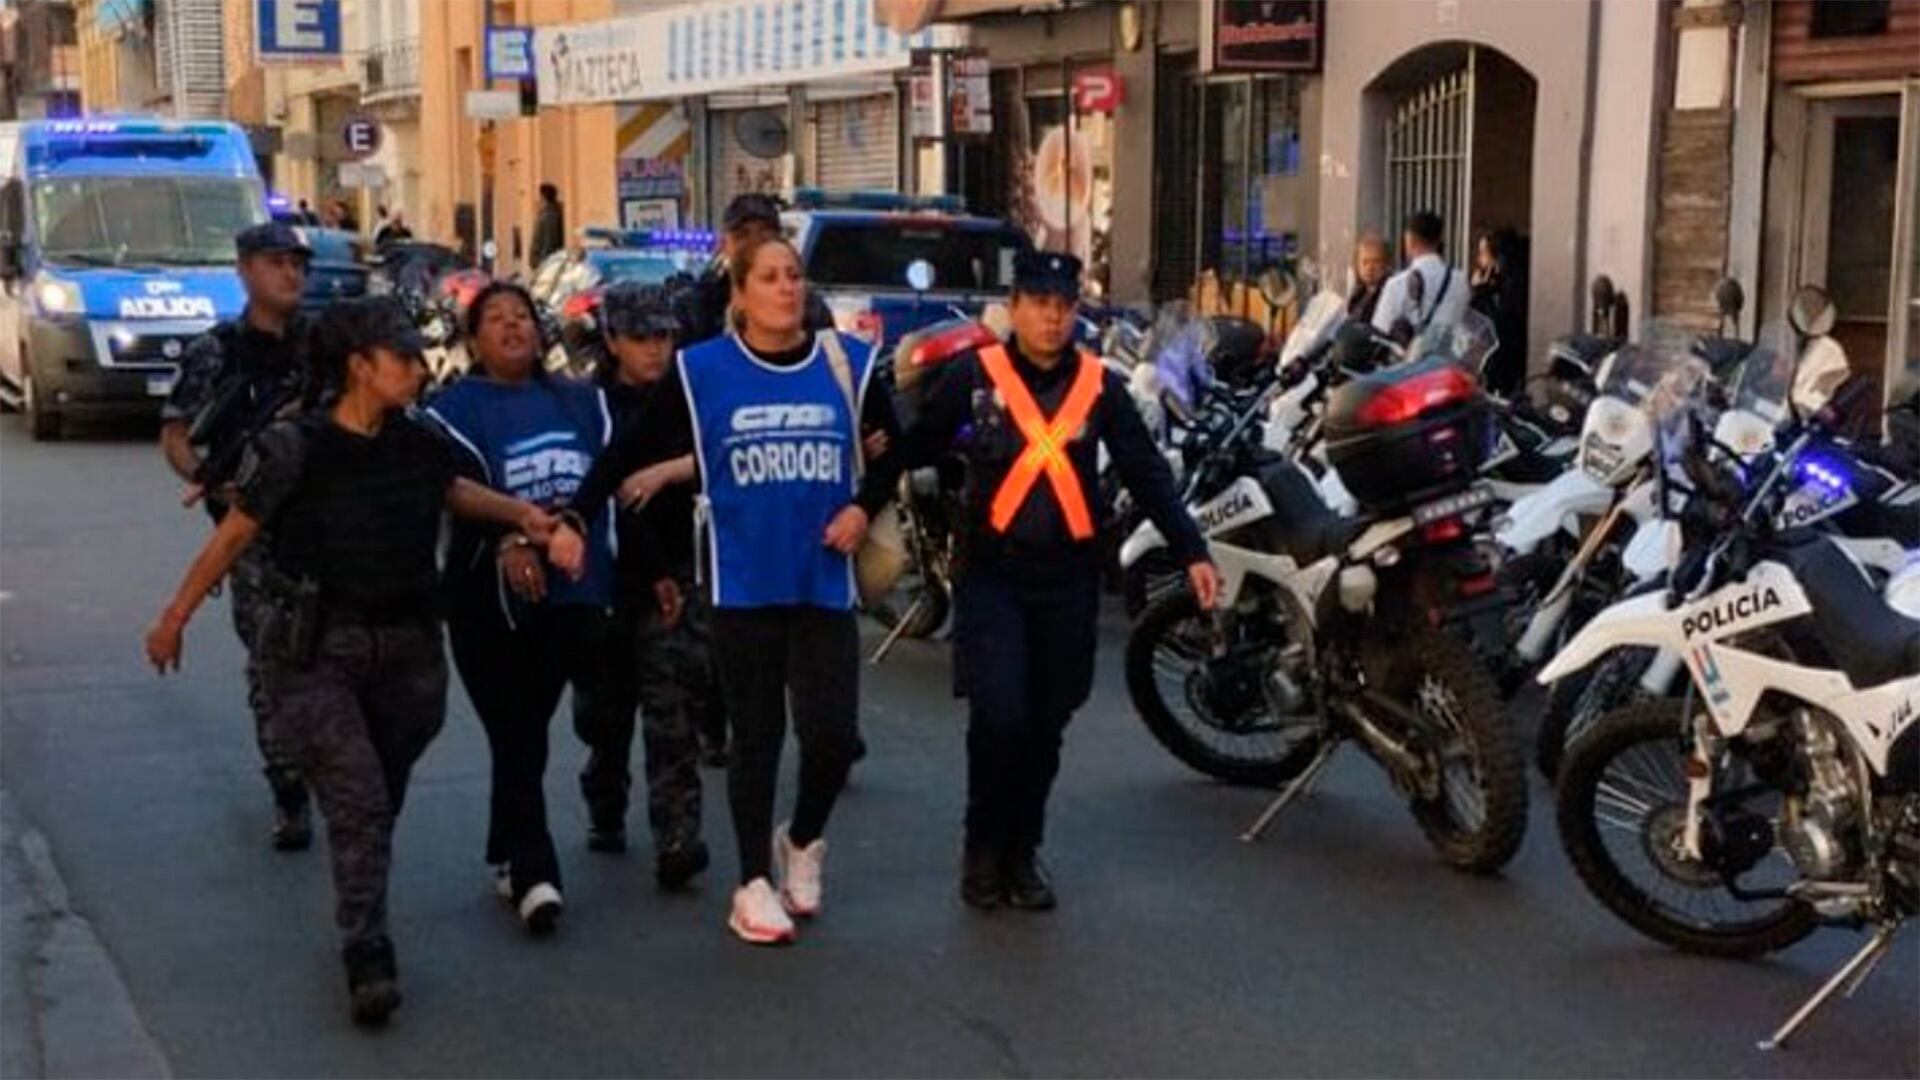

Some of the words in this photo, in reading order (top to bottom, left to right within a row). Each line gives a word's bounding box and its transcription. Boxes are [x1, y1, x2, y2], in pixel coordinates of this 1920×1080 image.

[275, 0, 325, 48] E
[489, 30, 529, 75] E
[349, 123, 371, 151] E
[1199, 489, 1255, 533] OLICÍA
[1681, 584, 1782, 640] POLICÍA
